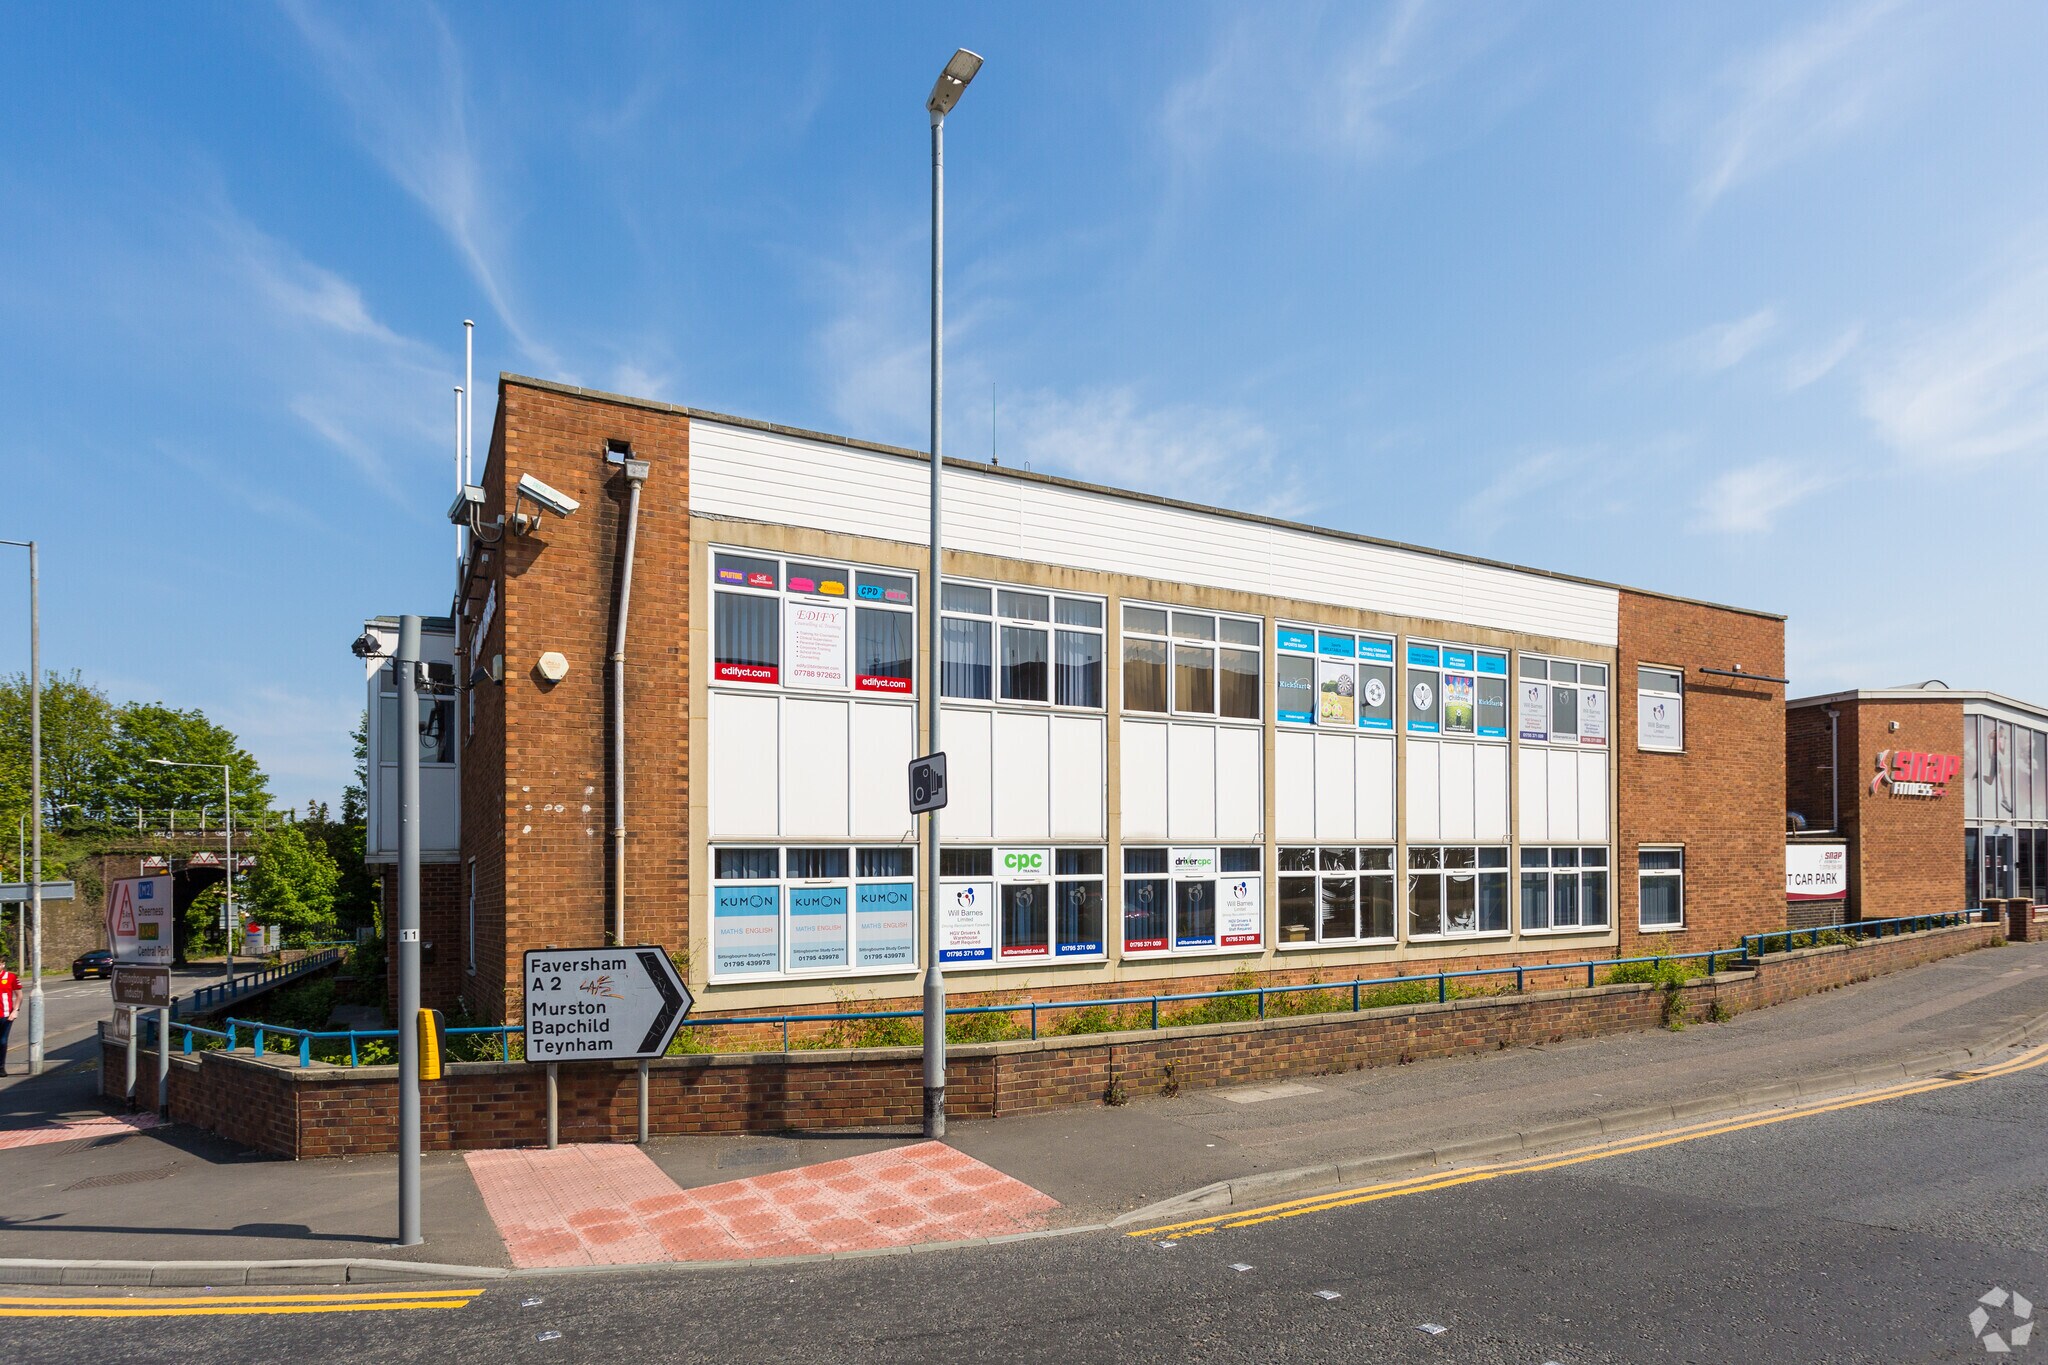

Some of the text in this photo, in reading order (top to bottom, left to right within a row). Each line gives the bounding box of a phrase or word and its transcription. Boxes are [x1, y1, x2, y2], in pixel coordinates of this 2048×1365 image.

[861, 586, 878, 596] CPD
[796, 610, 839, 622] EDIFY
[721, 667, 771, 678] edifyct.com
[862, 678, 906, 688] edifyct.com
[1005, 854, 1042, 872] cpc
[1795, 873, 1813, 885] CAR
[1816, 873, 1837, 884] PARK
[721, 895, 773, 908] KUMON
[795, 895, 841, 907] KUMON
[861, 892, 907, 904] KUMON
[139, 905, 164, 916] Sheerness
[138, 945, 169, 956] Central Park
[531, 957, 626, 973] Faversham
[119, 973, 150, 986] Sittingbourne
[532, 1001, 606, 1016] Murston
[533, 1019, 609, 1036] Bapchild
[534, 1038, 612, 1055] Teynham
